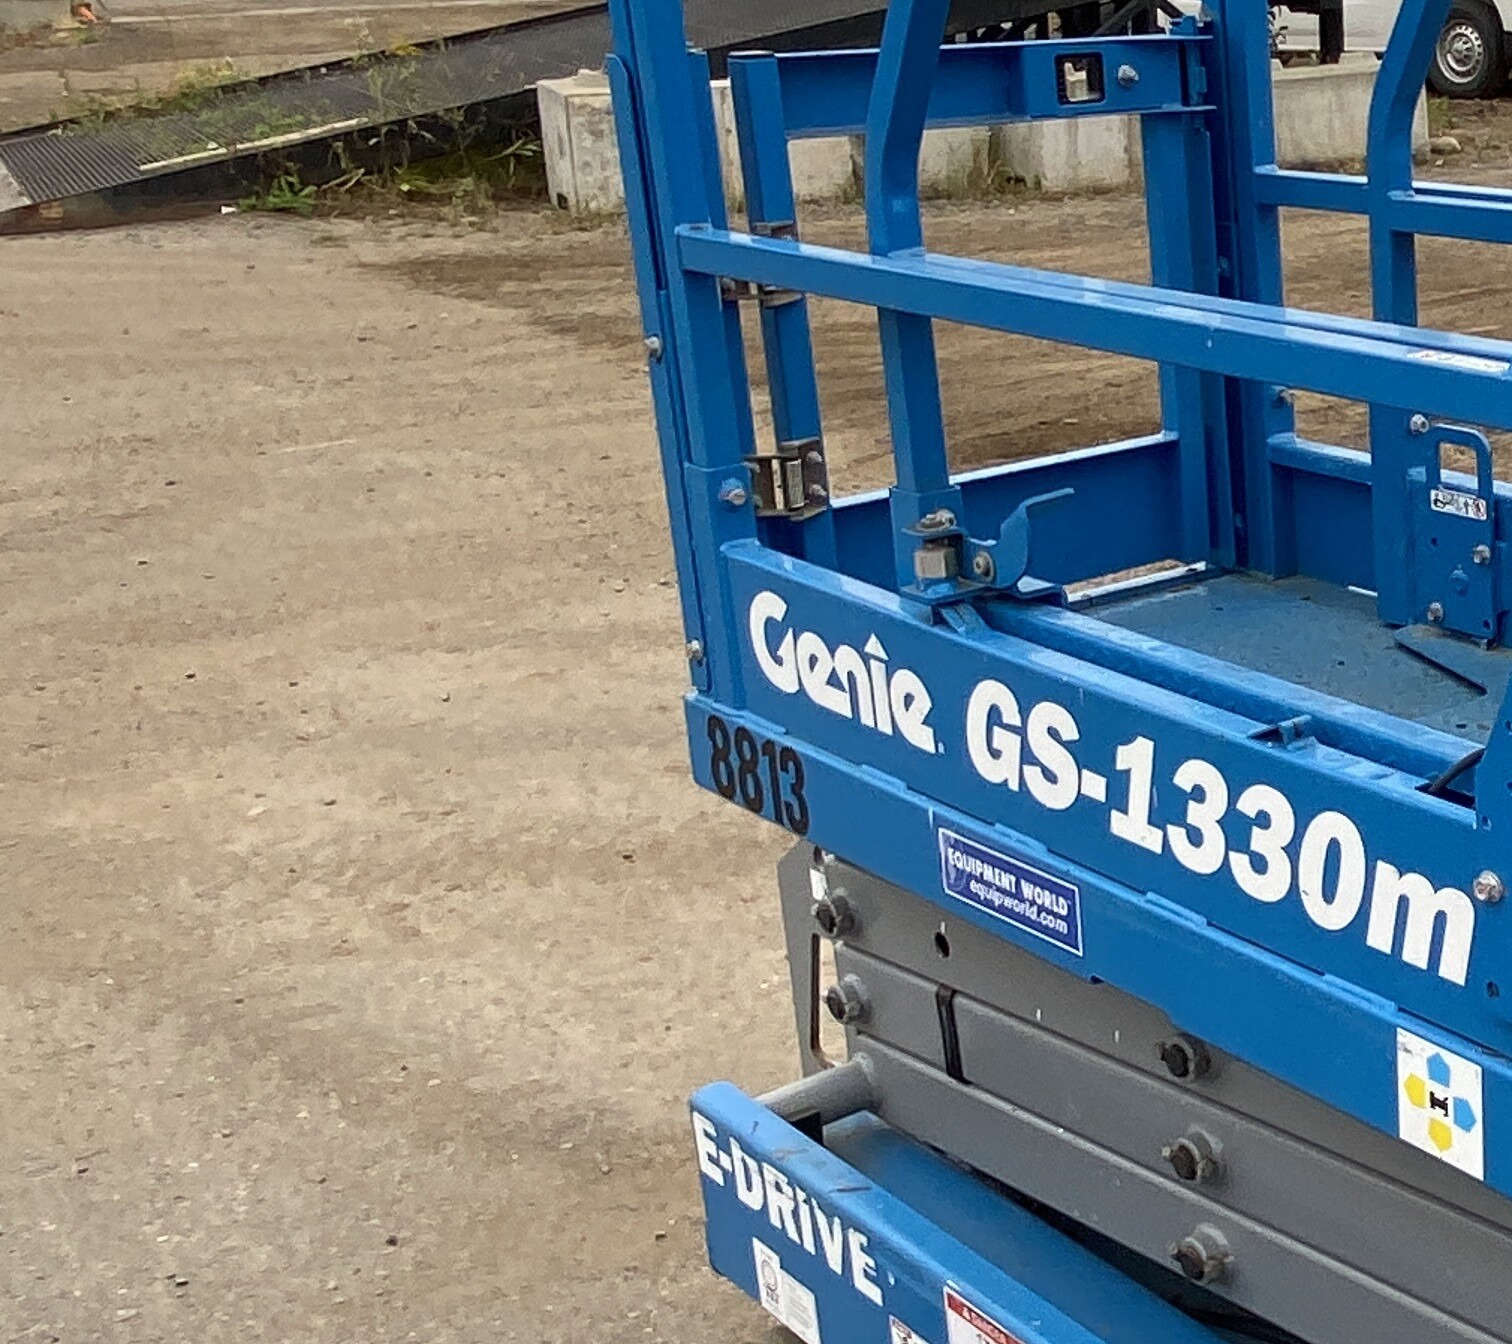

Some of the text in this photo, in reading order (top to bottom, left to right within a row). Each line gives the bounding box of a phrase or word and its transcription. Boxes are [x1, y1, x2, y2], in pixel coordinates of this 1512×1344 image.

[707, 714, 811, 837] 8813
[751, 590, 1476, 987] Genie GS-1330m
[947, 847, 1069, 918] EQUIPMENT WORLD
[969, 879, 1069, 935] equipworld.com
[692, 1110, 884, 1307] E-DRIVE
